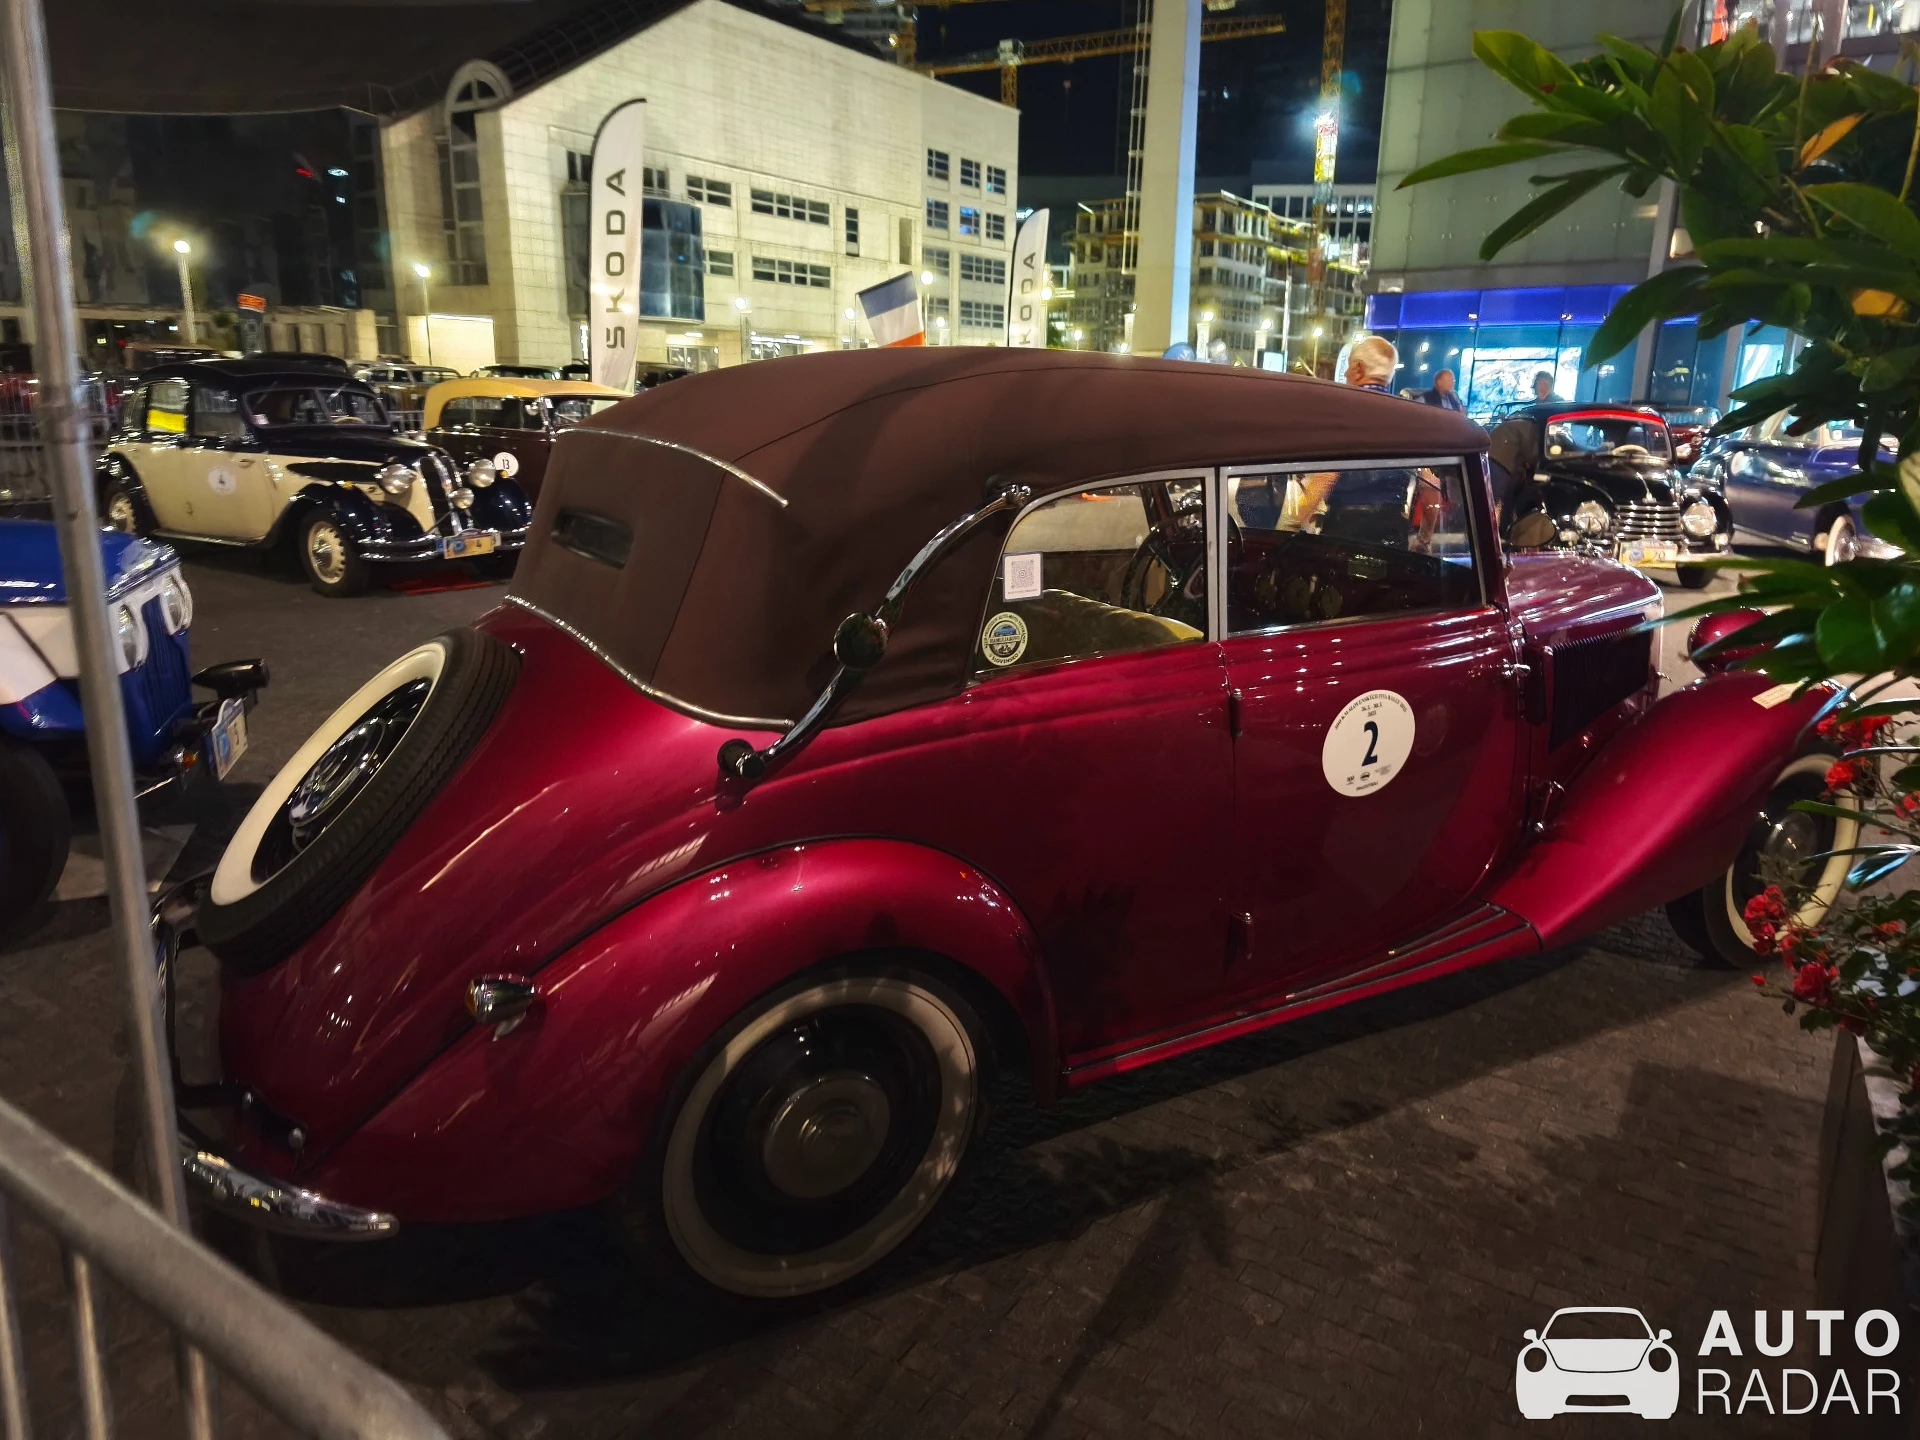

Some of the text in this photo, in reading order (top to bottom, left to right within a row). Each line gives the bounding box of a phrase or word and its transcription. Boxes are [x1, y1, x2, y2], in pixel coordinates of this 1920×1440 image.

[1019, 251, 1036, 345] KODA
[502, 458, 510, 470] 13
[1361, 720, 1379, 767] 2
